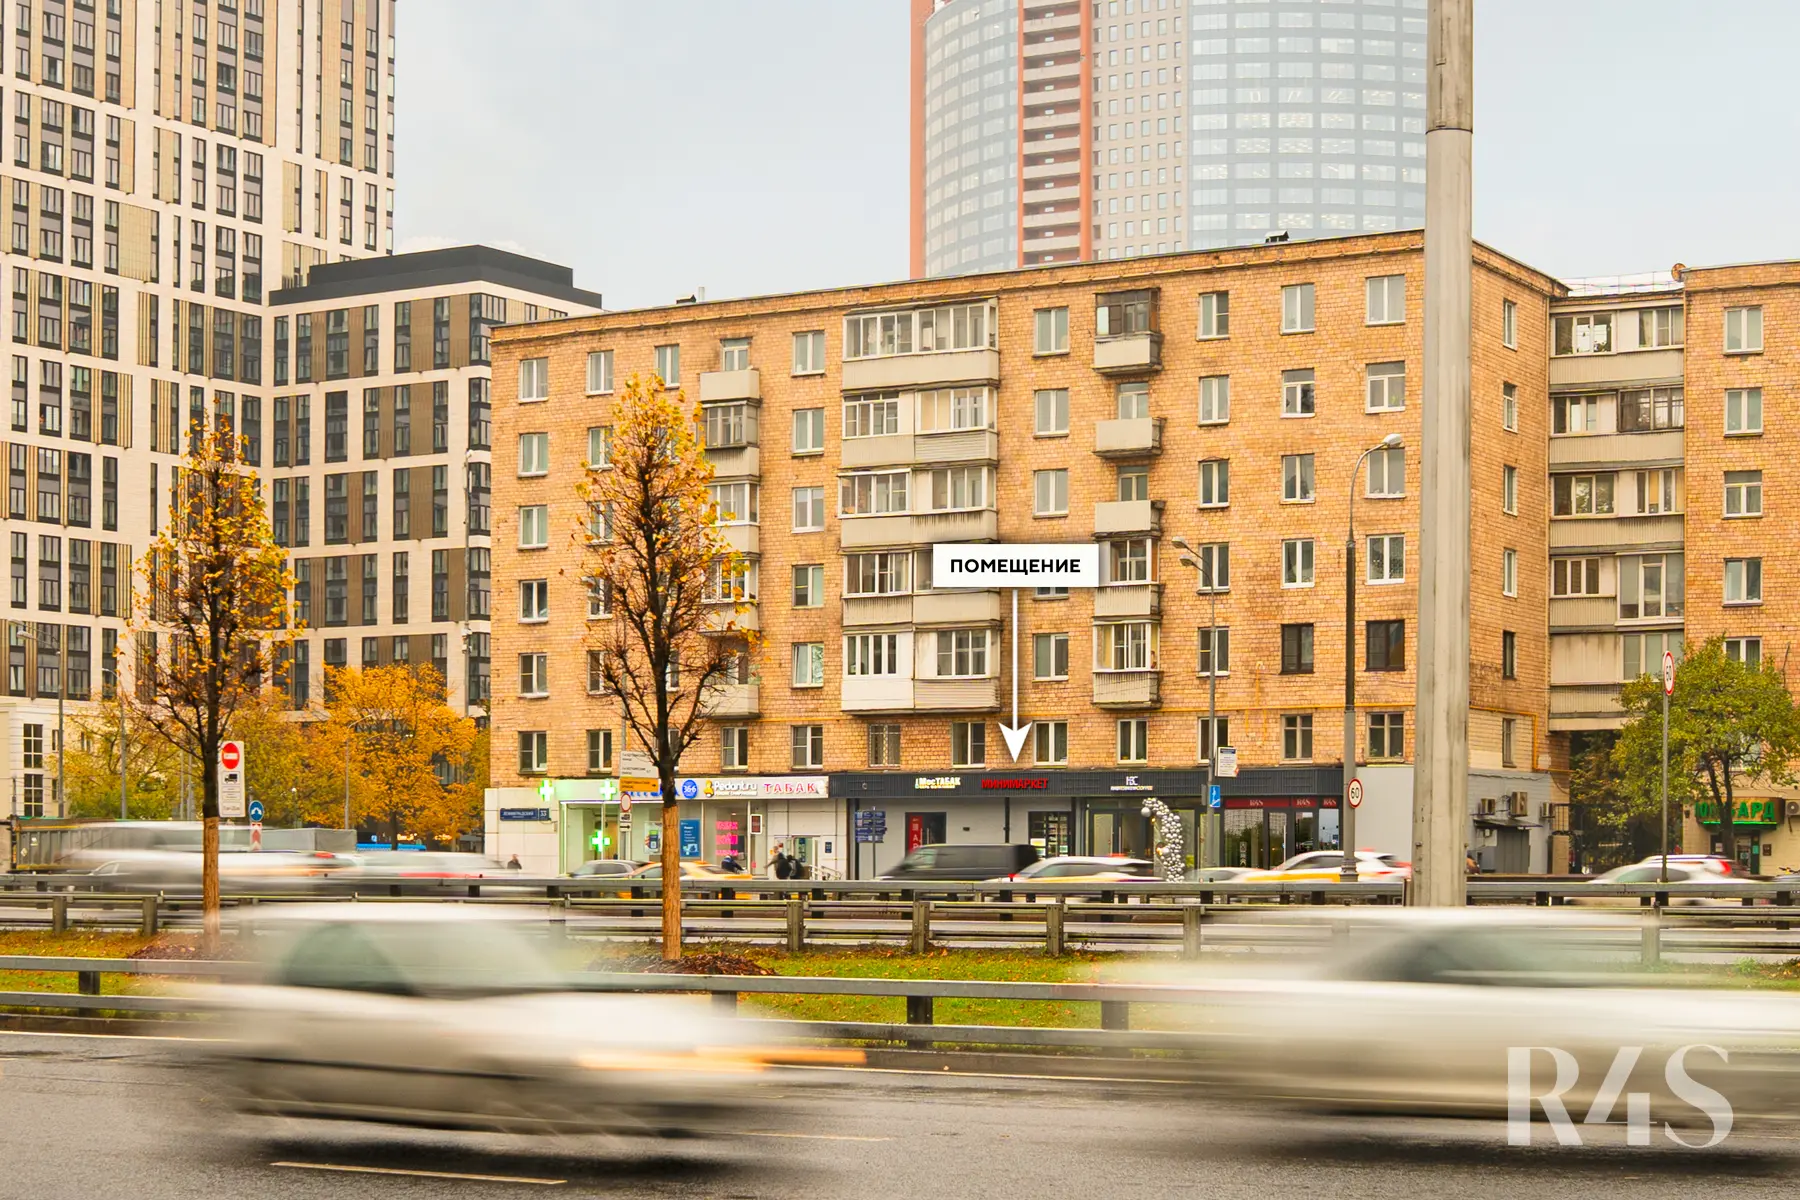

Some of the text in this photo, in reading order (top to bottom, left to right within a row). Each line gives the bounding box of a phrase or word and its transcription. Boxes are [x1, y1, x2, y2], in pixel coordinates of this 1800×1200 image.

[763, 783, 816, 794] ТАБАК
[981, 777, 1049, 789] МИНИМАРКЕТ
[1350, 787, 1360, 799] 60
[1695, 802, 1776, 820] ОАРД
